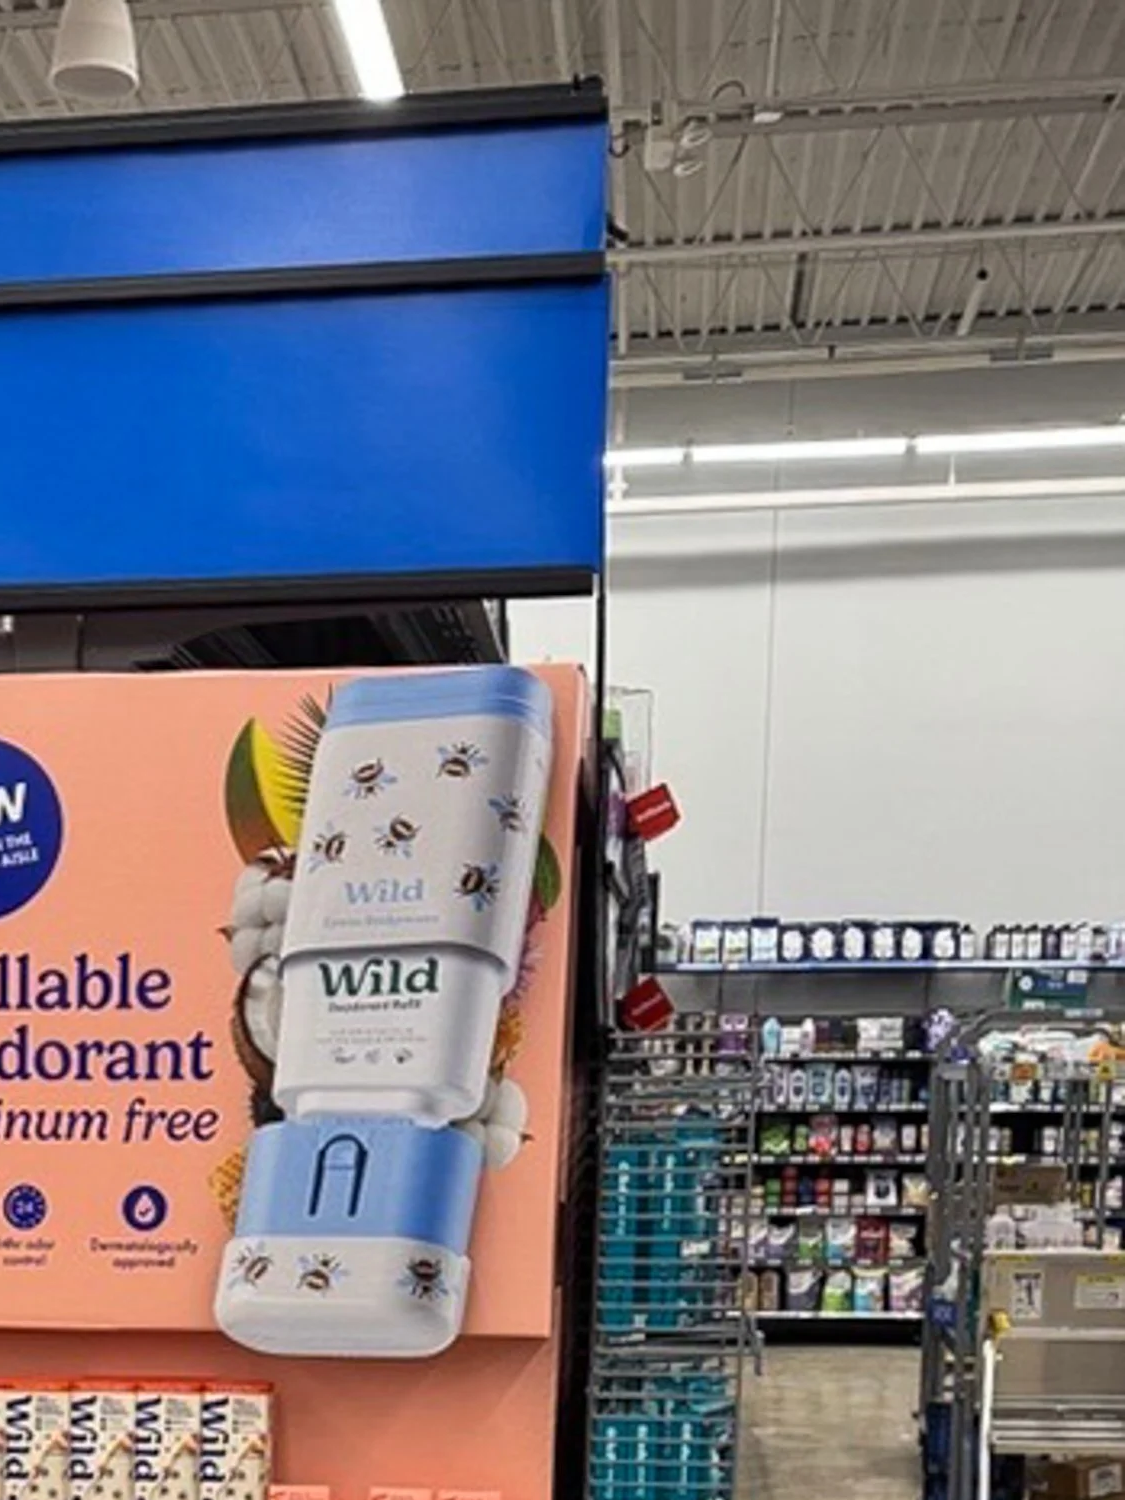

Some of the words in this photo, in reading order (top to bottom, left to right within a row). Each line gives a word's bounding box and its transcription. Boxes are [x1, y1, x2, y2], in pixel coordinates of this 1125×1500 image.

[0, 847, 40, 868] AISLE
[5, 831, 33, 850] THE
[344, 878, 425, 904] Wild
[318, 955, 441, 998] Wild
[120, 1098, 221, 1145] free
[6, 1394, 33, 1480] Wild
[71, 1395, 98, 1480] Wild
[134, 1396, 162, 1482] Wild
[200, 1397, 229, 1484] Wild
